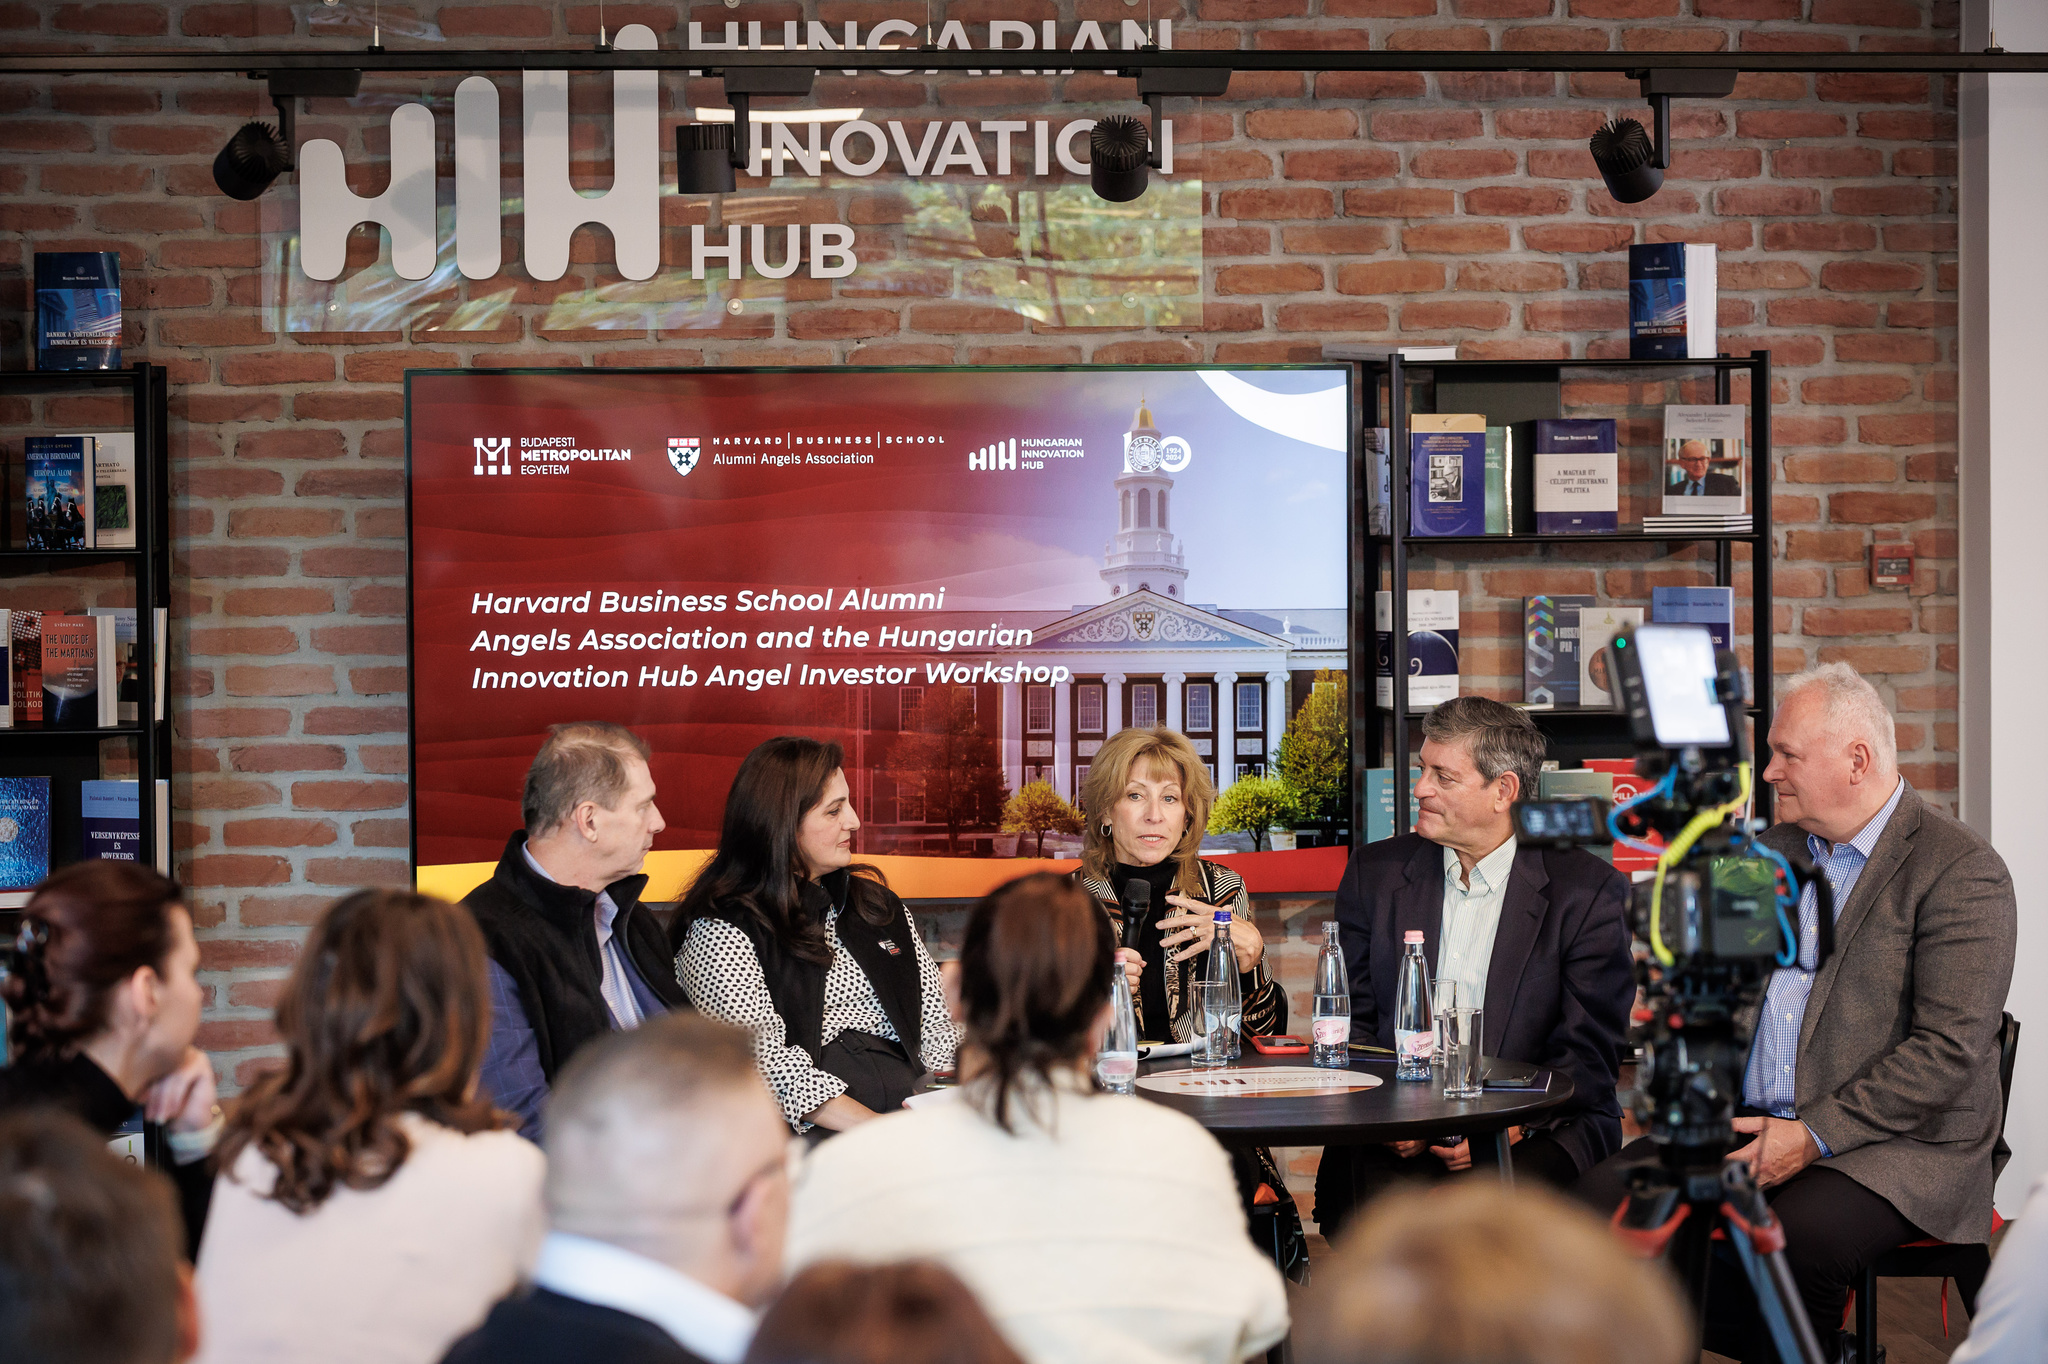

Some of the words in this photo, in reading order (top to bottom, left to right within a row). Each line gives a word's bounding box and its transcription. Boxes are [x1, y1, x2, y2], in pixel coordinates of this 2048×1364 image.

[690, 119, 1174, 177] NOVATIO
[692, 224, 857, 280] HUB
[520, 437, 575, 447] BUDAPESTI
[713, 437, 782, 445] HARVARD
[796, 436, 873, 445] BUSINESS
[886, 435, 945, 444] SCHOOL
[1021, 438, 1082, 447] HUNGARIAN
[520, 449, 631, 461] METROPOLITAN
[1021, 449, 1085, 459] INNOVATION
[713, 453, 756, 465] Alumni
[760, 453, 801, 467] Angels
[805, 452, 874, 465] Association
[520, 465, 570, 475] EGYETEM
[1021, 461, 1044, 470] HUB
[471, 591, 591, 614] Harvard
[599, 589, 727, 613] Business
[735, 588, 833, 612] School
[839, 587, 946, 610] Alumni
[45, 634, 57, 645] THE
[60, 634, 78, 645] VOICE
[81, 634, 89, 645] OF
[470, 628, 571, 656] Angels
[578, 626, 747, 650] Association
[756, 626, 814, 649] and
[822, 626, 869, 648] the
[878, 623, 1033, 652] Hungarian
[45, 648, 58, 658] THE
[60, 648, 95, 658] MARTIANS
[472, 665, 629, 689] Innovation
[638, 664, 698, 687] Hub
[705, 664, 791, 691] Angel
[800, 663, 916, 685] Investor
[926, 661, 1069, 688] Workshop
[114, 841, 121, 850] ÉS
[101, 852, 134, 860] NÖVEKEDÉS
